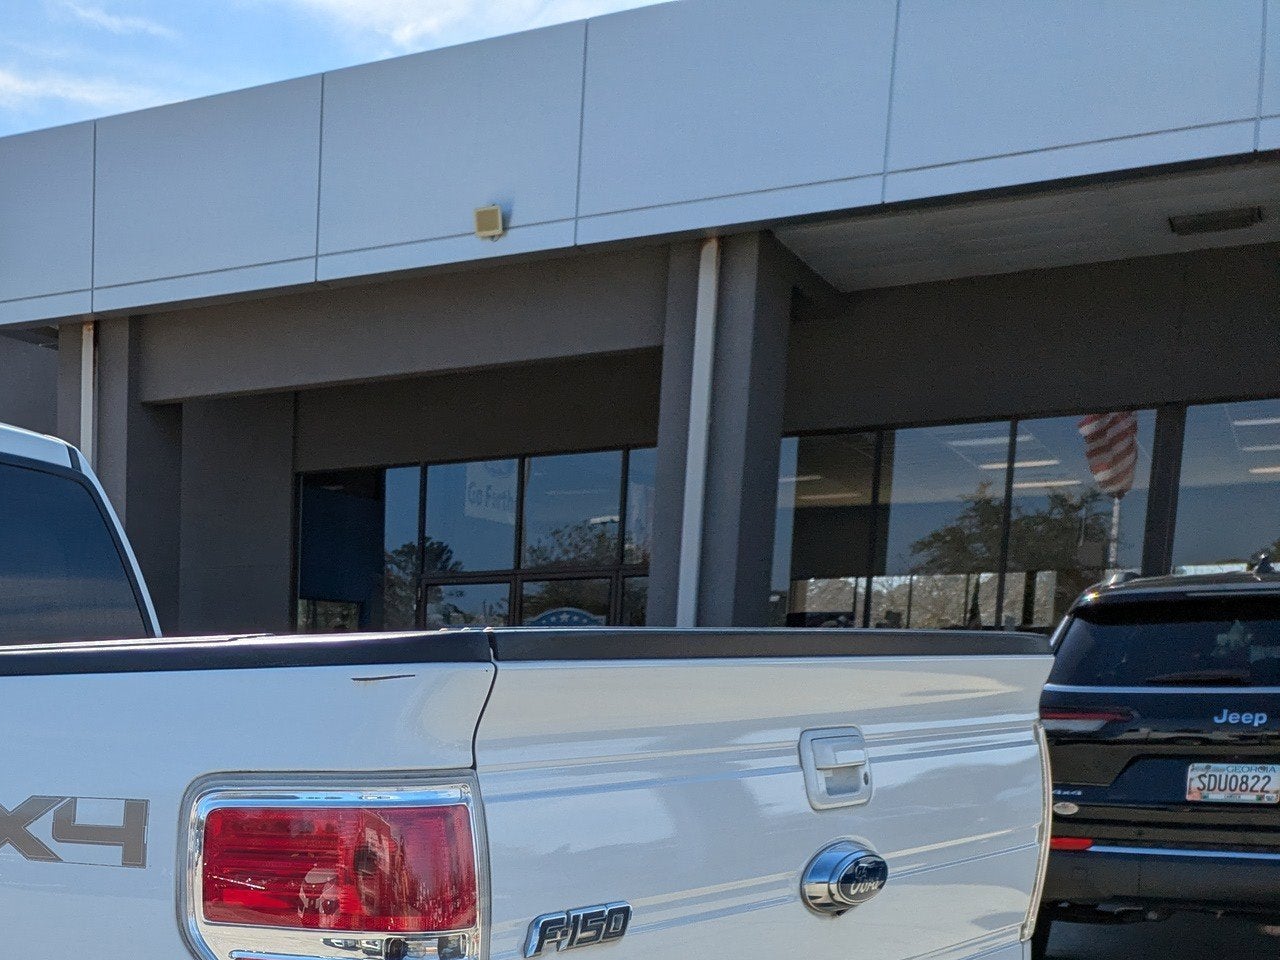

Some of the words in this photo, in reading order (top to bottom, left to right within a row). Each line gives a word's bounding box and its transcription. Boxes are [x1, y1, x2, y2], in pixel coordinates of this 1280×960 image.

[1213, 708, 1268, 728] Jeep
[1225, 765, 1276, 774] GEORGIA
[1196, 773, 1272, 794] SDU0822
[523, 900, 633, 959] F-150
